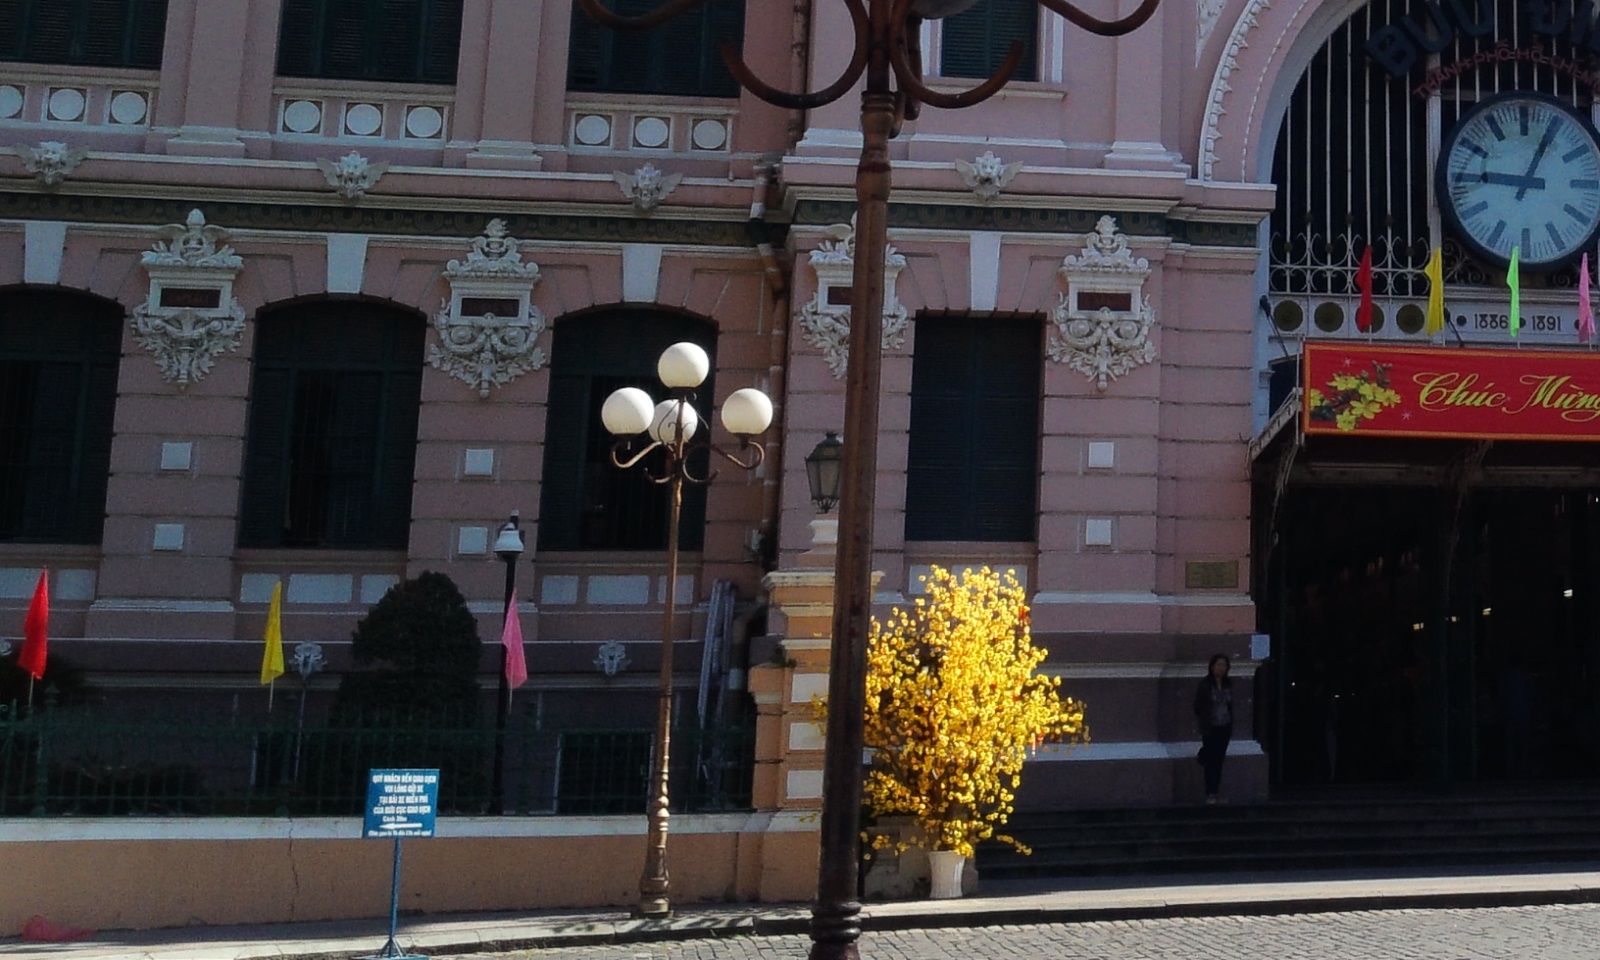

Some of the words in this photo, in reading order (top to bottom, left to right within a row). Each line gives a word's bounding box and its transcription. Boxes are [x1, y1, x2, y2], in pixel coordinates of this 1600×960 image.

[1474, 313, 1509, 330] 1886
[1532, 315, 1561, 331] 1891
[1413, 372, 1505, 411] Chúc
